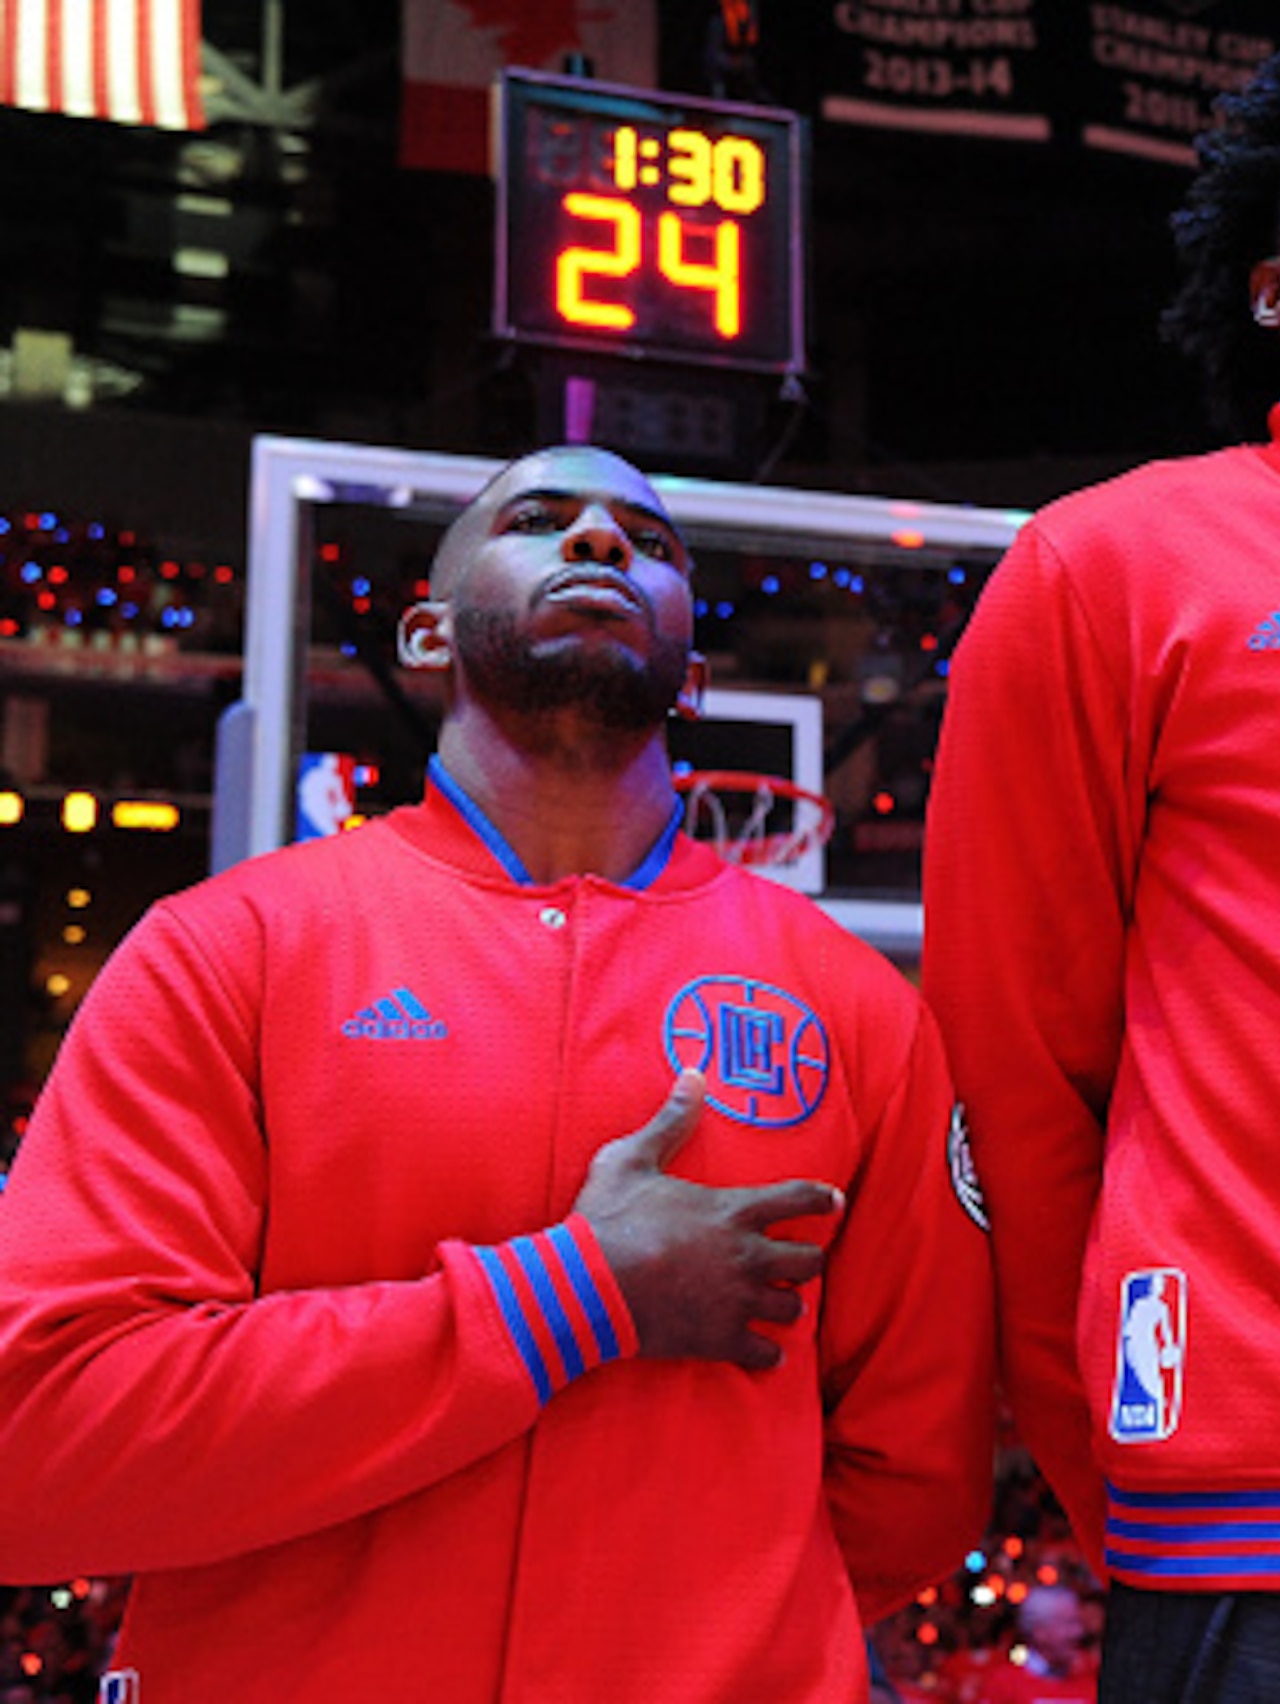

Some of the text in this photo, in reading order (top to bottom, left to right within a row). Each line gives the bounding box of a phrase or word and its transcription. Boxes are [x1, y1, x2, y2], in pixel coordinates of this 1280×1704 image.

[835, 3, 1037, 48] CHAMPIONS
[863, 49, 1013, 96] 2013-14
[613, 125, 766, 214] 1:30
[556, 192, 742, 339] 24
[341, 1019, 448, 1041] adidas
